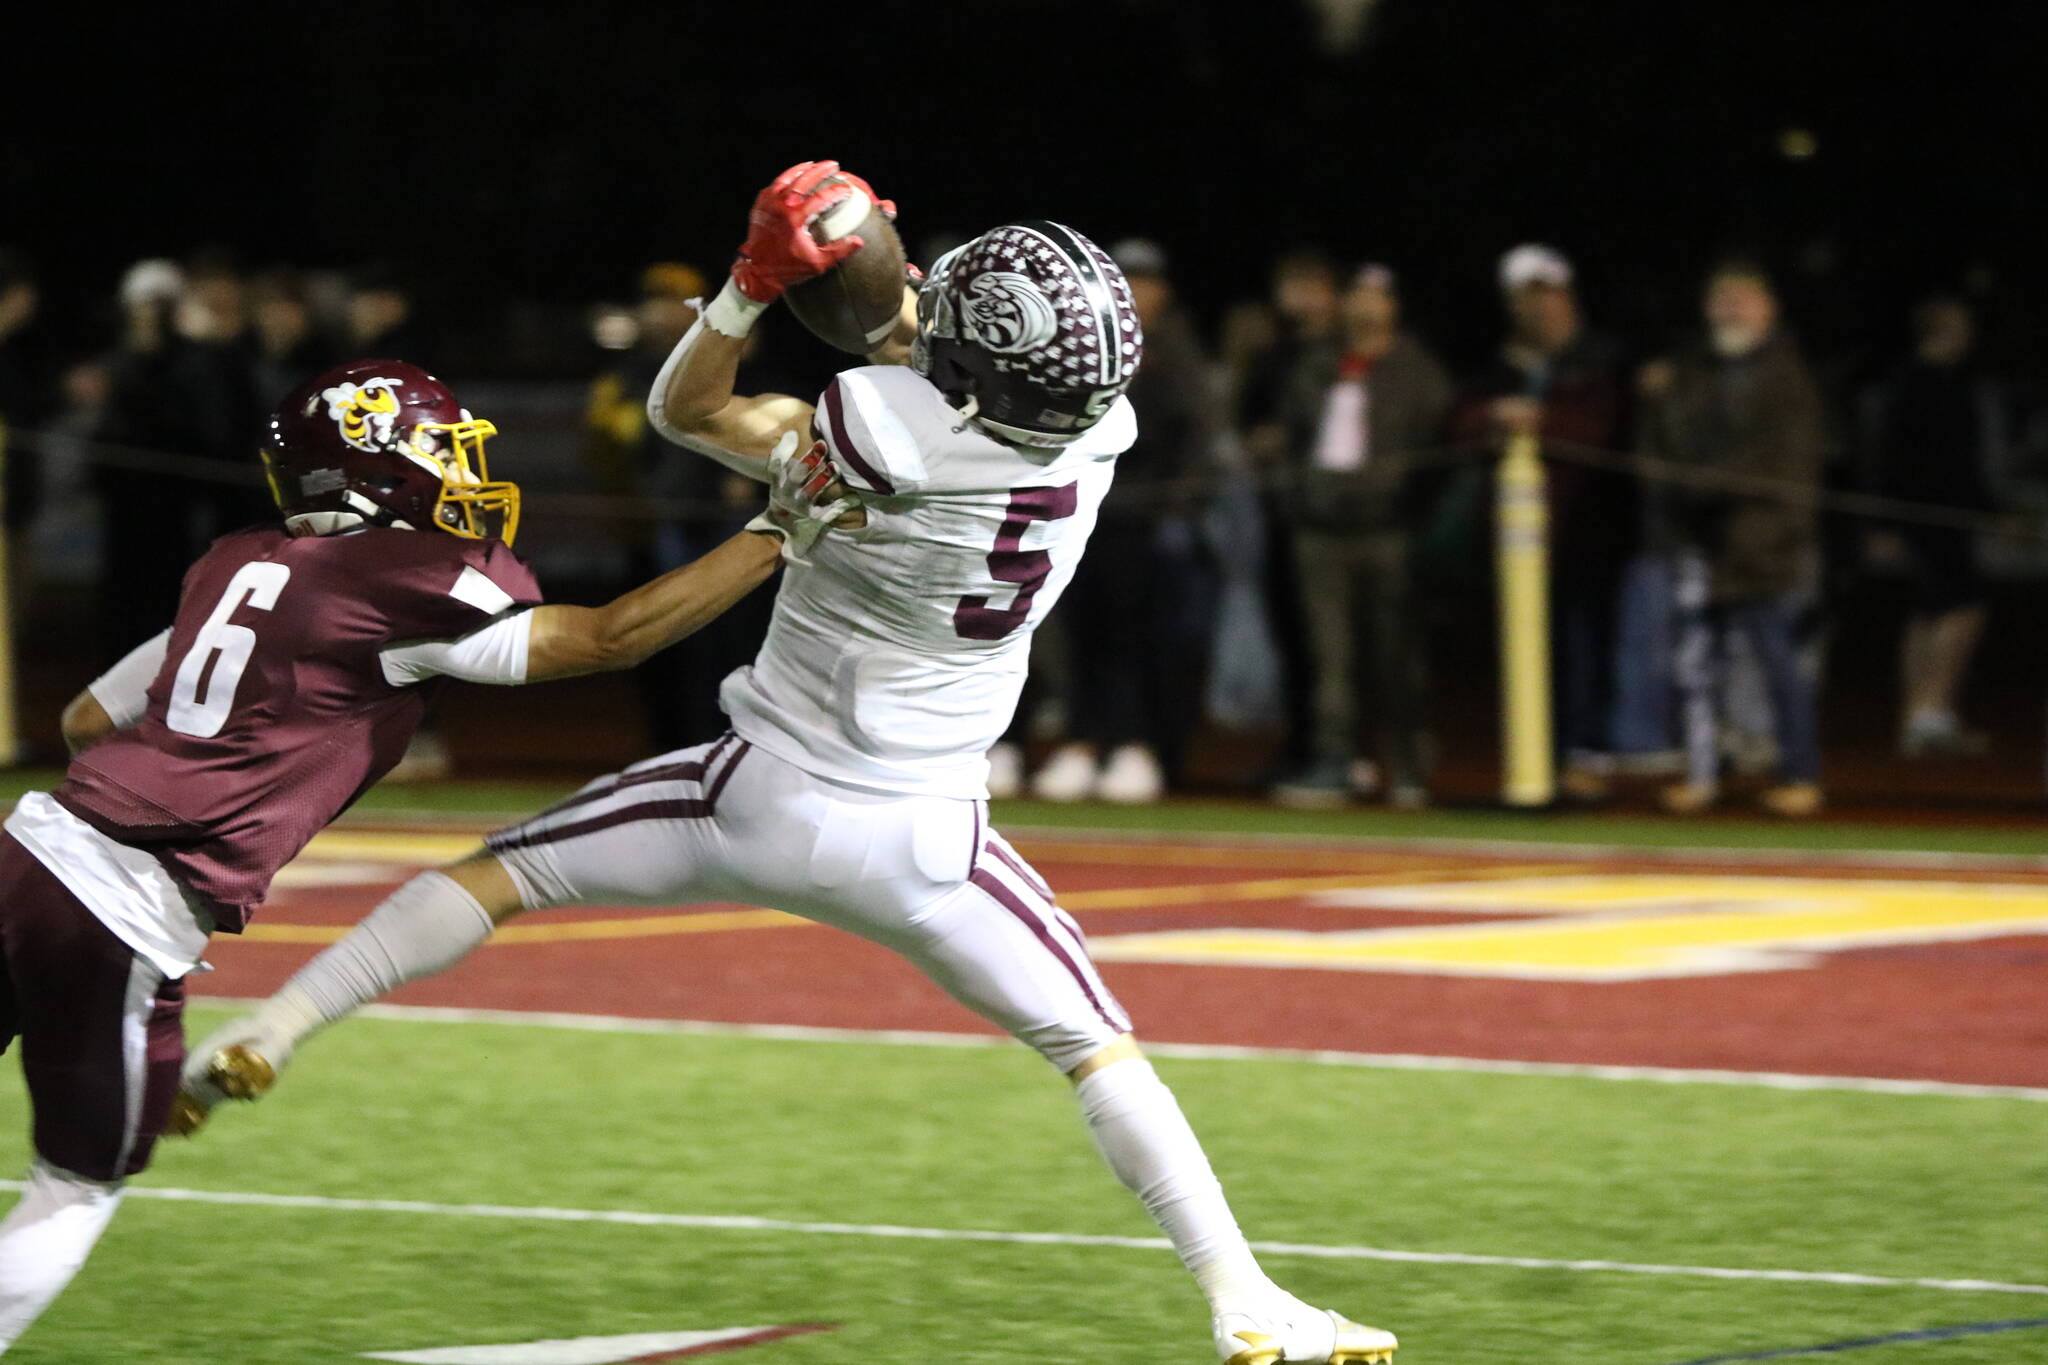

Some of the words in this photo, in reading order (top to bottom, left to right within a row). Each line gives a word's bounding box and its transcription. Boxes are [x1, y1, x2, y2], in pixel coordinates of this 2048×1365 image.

[1075, 390, 1118, 428] 5
[953, 481, 1078, 640] 5
[166, 561, 291, 739] 6
